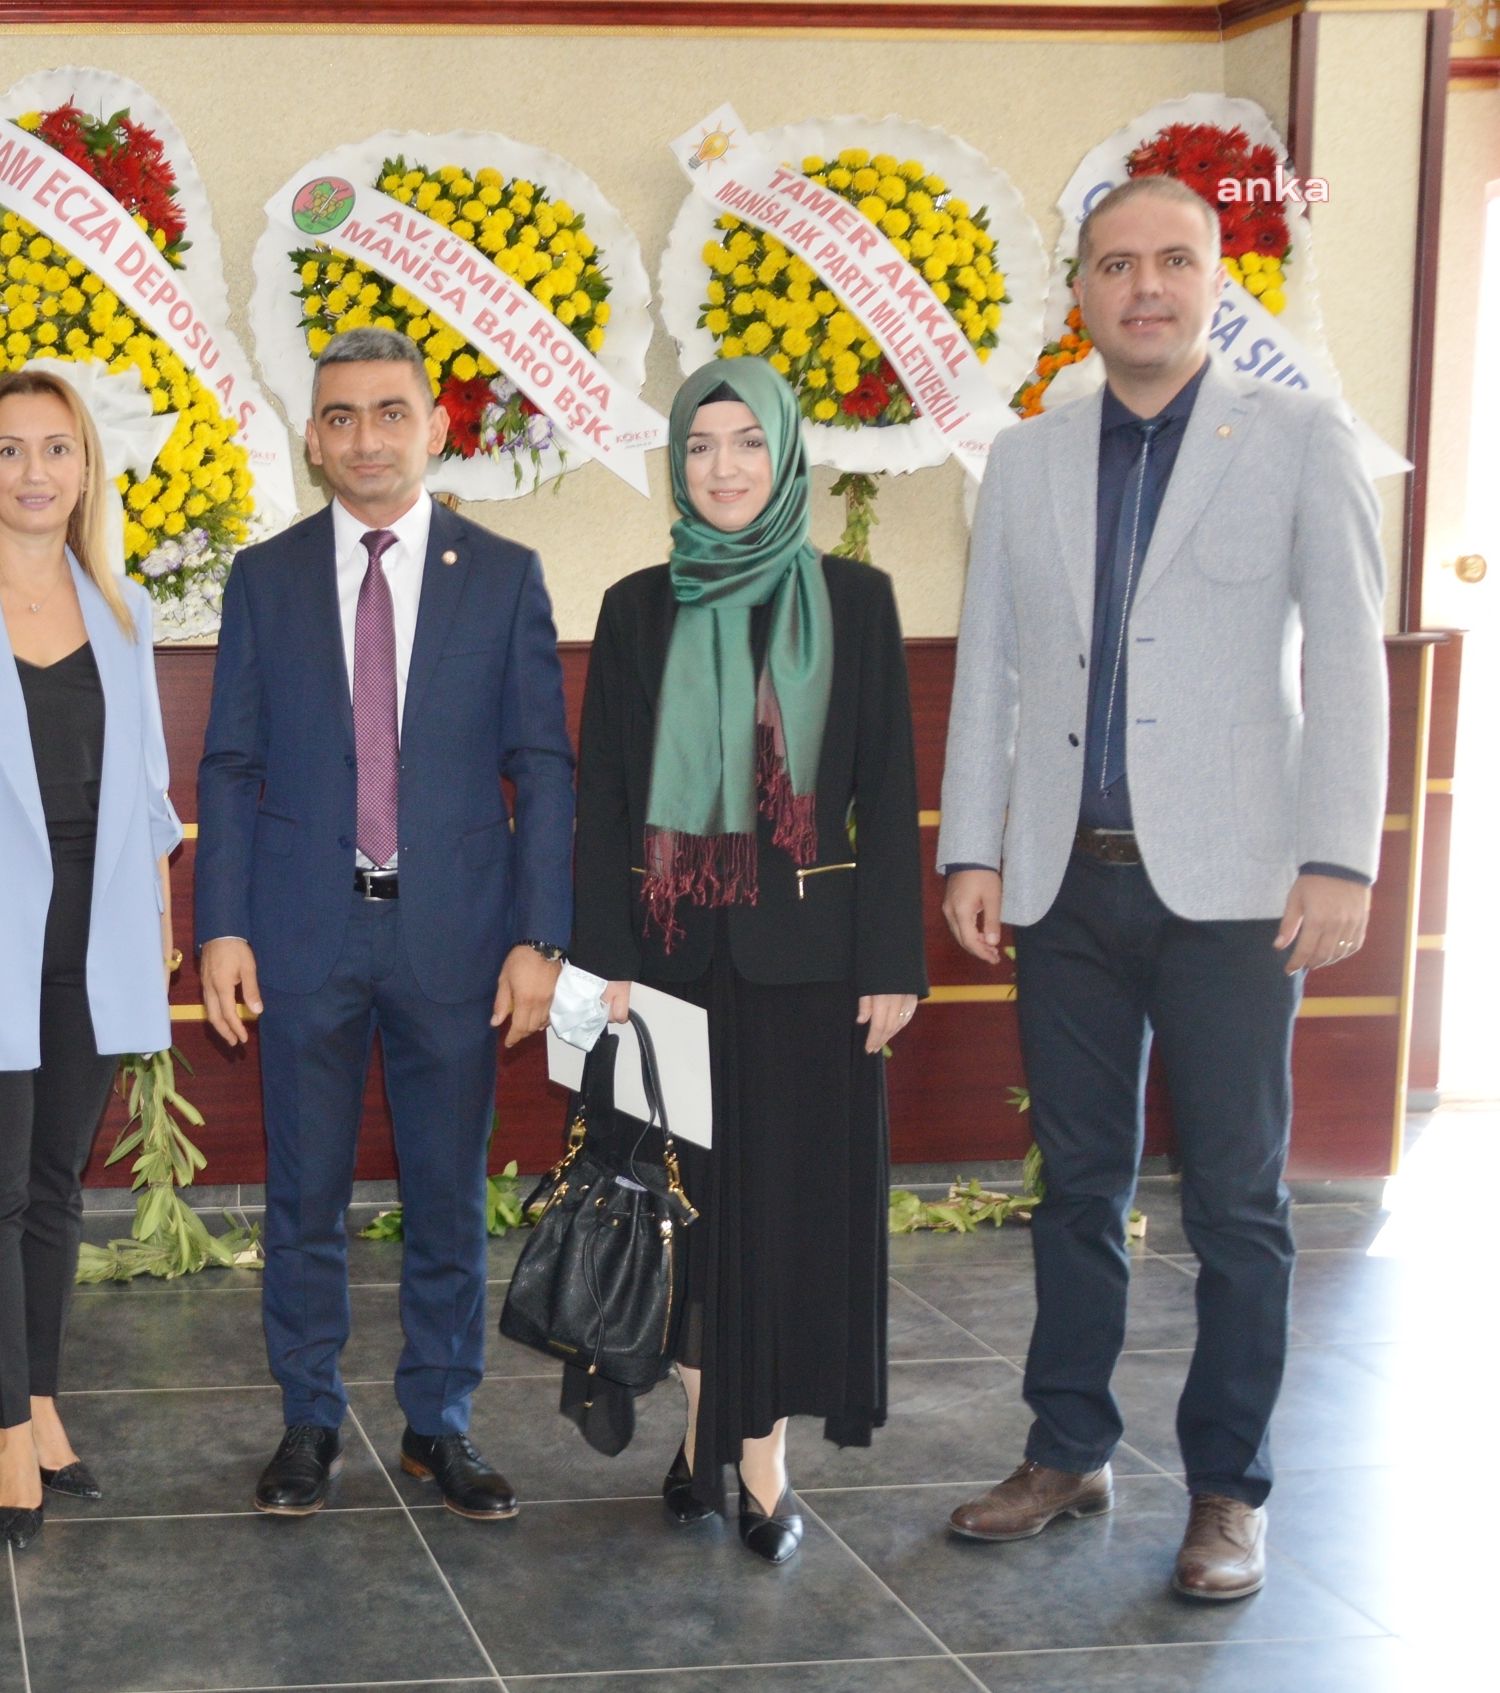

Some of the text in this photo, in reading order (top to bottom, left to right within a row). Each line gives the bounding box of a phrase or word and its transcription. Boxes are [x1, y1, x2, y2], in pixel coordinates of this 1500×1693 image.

[32, 168, 122, 255] ECZA
[114, 239, 221, 370] DEPOSU
[340, 218, 613, 452] MANİSA BARO BŞK.
[528, 316, 611, 411] RONA
[714, 179, 971, 435] MANİSA AK PARTİ MİLLETVEKİLİ
[765, 168, 970, 379] TAMER AKKAL
